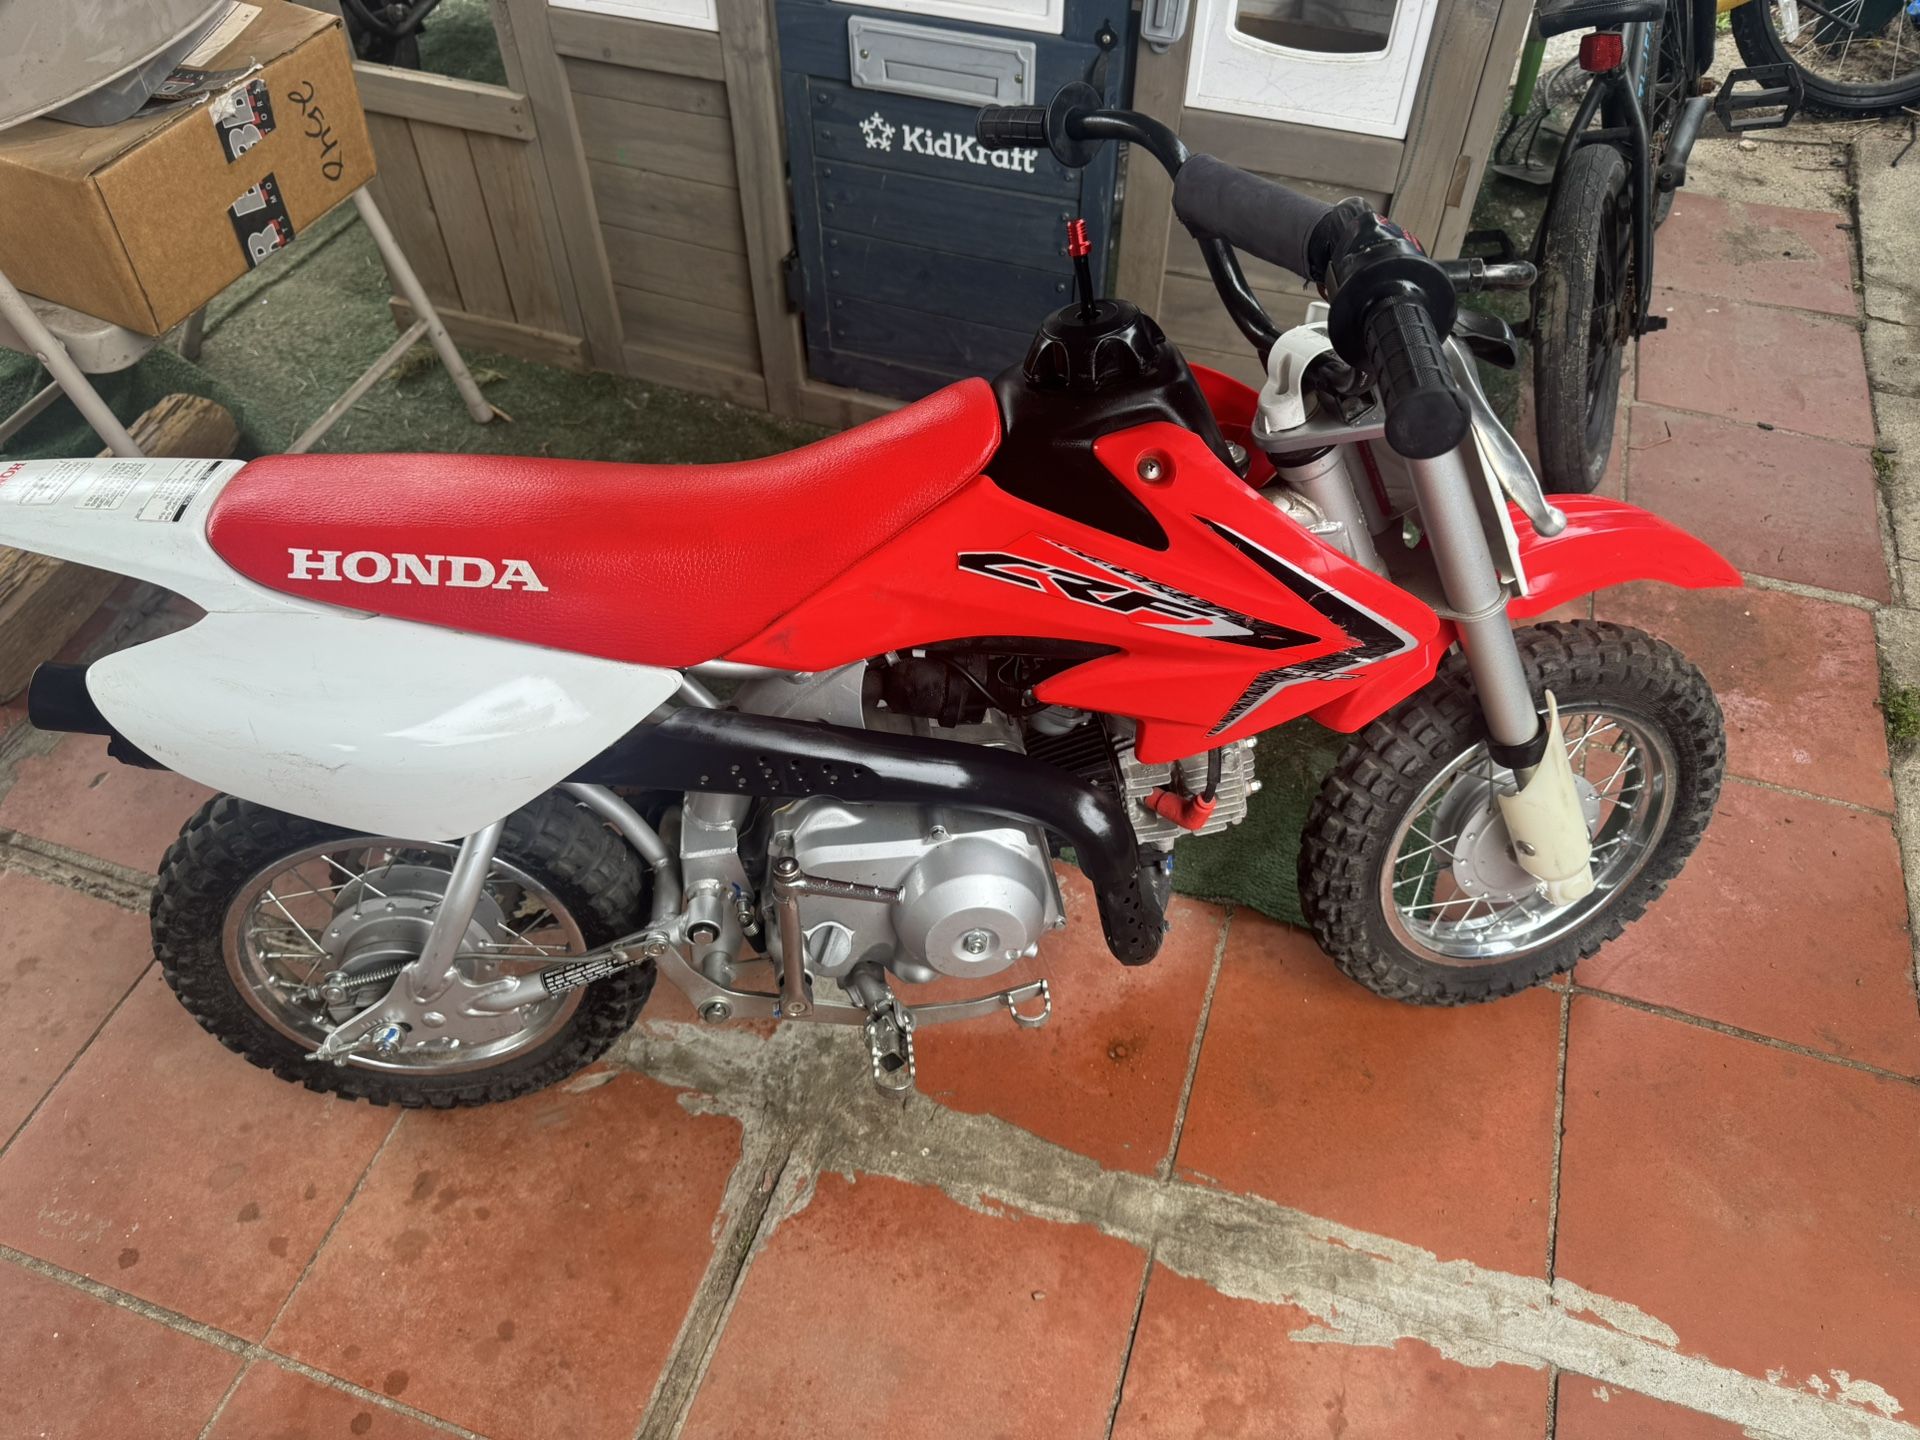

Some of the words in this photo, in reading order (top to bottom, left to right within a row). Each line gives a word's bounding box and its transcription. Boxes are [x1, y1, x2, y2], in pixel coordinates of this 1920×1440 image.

[287, 80, 344, 182] 2540
[901, 124, 1038, 173] KidKraft
[287, 547, 549, 592] HONDA
[956, 551, 1228, 622] CRF
